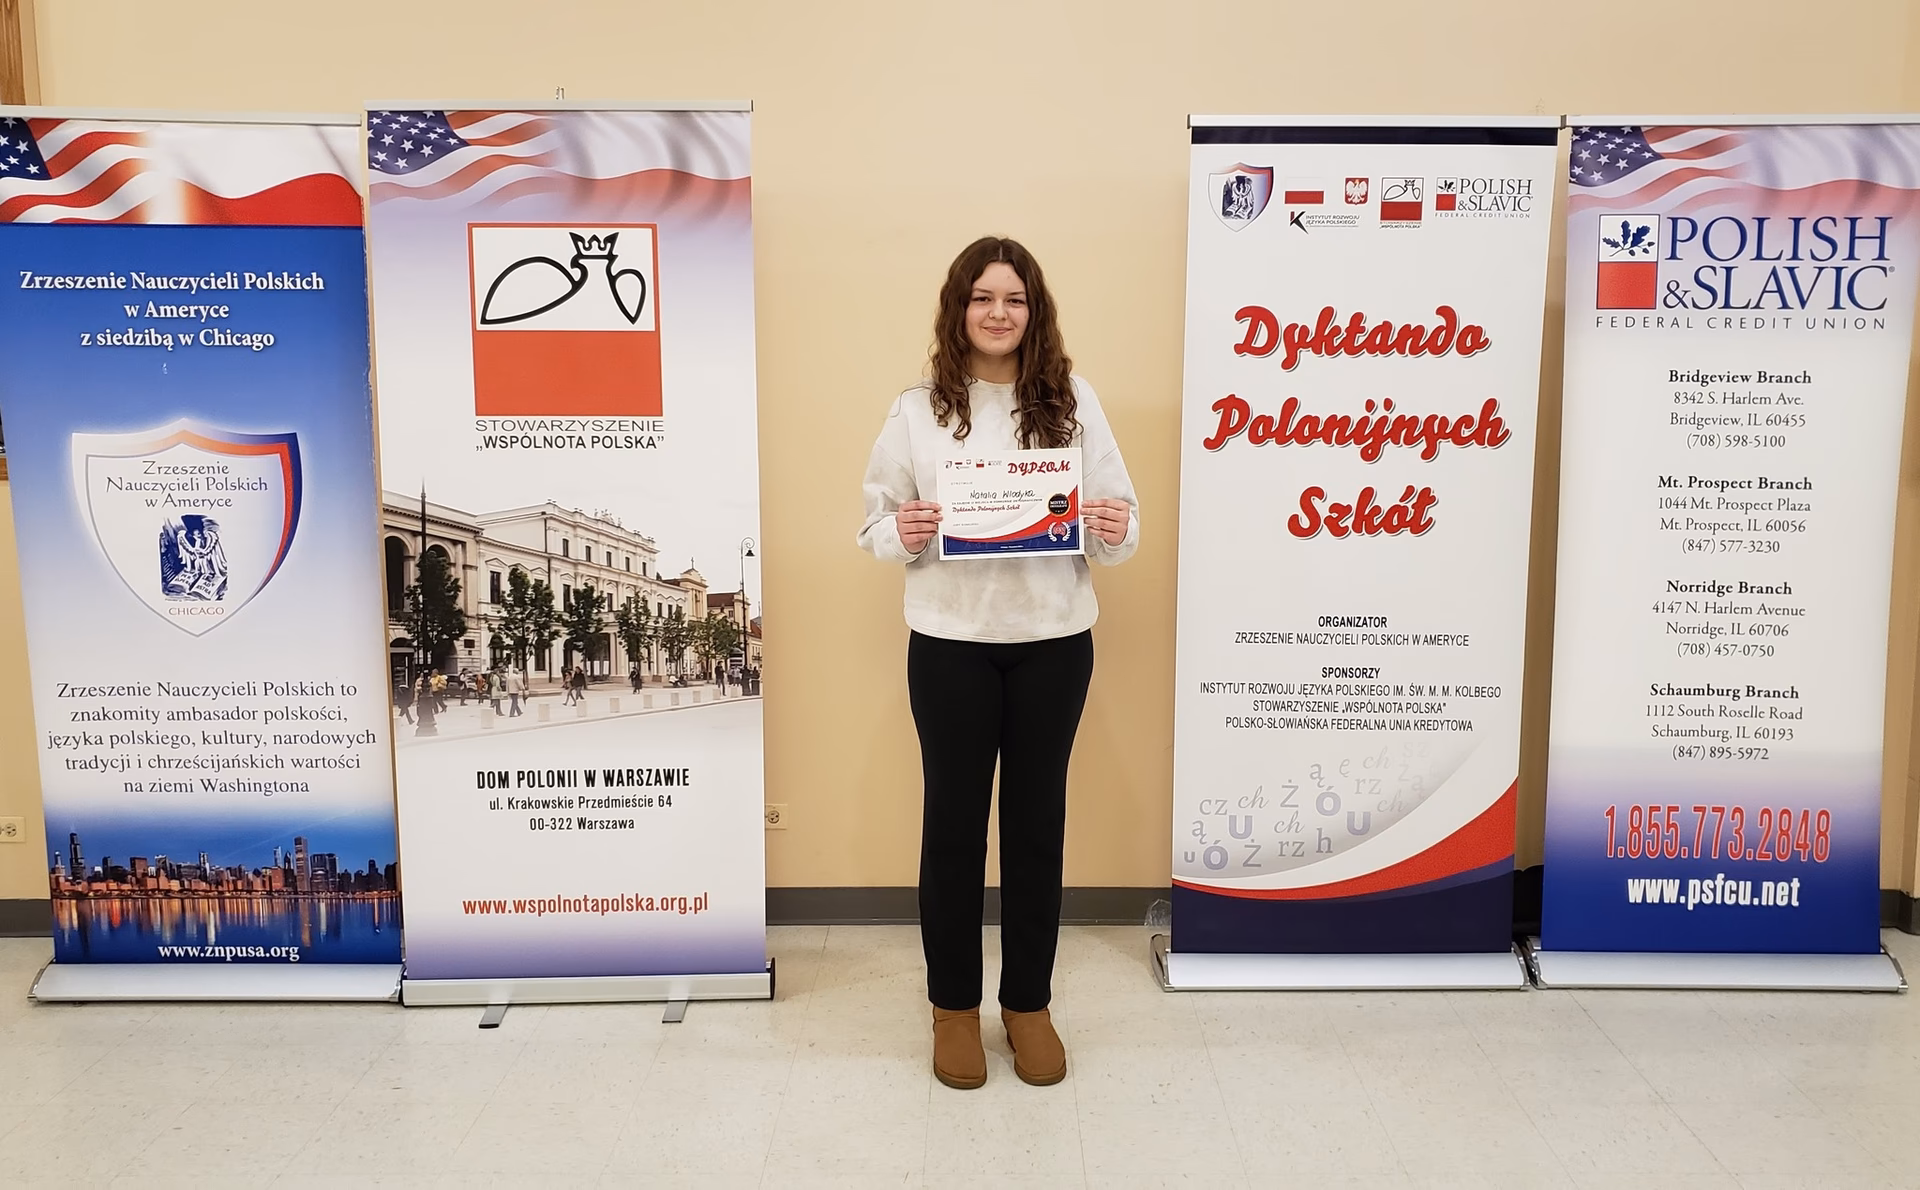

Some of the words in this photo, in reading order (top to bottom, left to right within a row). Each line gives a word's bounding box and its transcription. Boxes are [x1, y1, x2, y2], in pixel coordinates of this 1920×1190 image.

[1459, 178, 1532, 195] POLISH
[1664, 216, 1893, 262] POLISH
[20, 271, 127, 290] Zrzeszenie
[130, 271, 239, 292] Nauczycieli
[243, 272, 325, 290] Polskich
[125, 304, 140, 318] w
[144, 301, 229, 321] Ameryce
[1596, 316, 1693, 329] FEDERAL
[1707, 317, 1792, 329] CREDIT
[1806, 318, 1886, 330] UNION
[81, 332, 92, 347] z
[96, 330, 173, 351] siedzibą
[177, 332, 194, 347] w
[199, 329, 274, 351] Chicago
[1233, 305, 1490, 371] Dyktando
[1668, 370, 1752, 387] Bridgeview
[1756, 370, 1812, 384] Branch
[1673, 391, 1704, 405] 8342
[1707, 392, 1718, 405] S.
[1723, 392, 1772, 406] Harlem
[1775, 393, 1804, 406] Ave.
[475, 420, 664, 432] STOWARZYSZENIE
[1203, 394, 1511, 463] Polonijnych
[1669, 412, 1744, 428] Bridgeview,
[1747, 413, 1762, 426] IL
[1765, 413, 1806, 427] 60455
[475, 432, 586, 451] „WSPÓLNOTA
[1686, 433, 1722, 449] (708)
[1724, 434, 1786, 448] 598-5100
[142, 461, 230, 475] Zrzeszenie
[105, 476, 201, 494] Nauczycieli
[205, 476, 268, 492] Polskich
[1657, 475, 1683, 489] Mt.
[1687, 476, 1753, 492] Prospect
[1757, 477, 1813, 490] Branch
[145, 496, 157, 508] w
[160, 494, 233, 510] Ameryce
[970, 489, 997, 499] Natalia
[1658, 496, 1687, 509] 1044
[1690, 497, 1713, 510] Mt.
[1717, 498, 1773, 514] Prospect
[1776, 498, 1811, 512] Plaza
[1660, 518, 1682, 531] Mt.
[1686, 518, 1744, 535] Prospect,
[1747, 519, 1762, 532] IL
[1765, 519, 1806, 533] 60056
[1682, 538, 1716, 554] (847)
[1719, 539, 1780, 553] 577-3230
[1666, 580, 1733, 598] Norridge
[1738, 581, 1792, 595] Branch
[168, 607, 225, 616] CHICAGO
[1652, 600, 1682, 614] 4147
[1685, 601, 1700, 614] N.
[1704, 601, 1752, 615] Harlem
[1756, 603, 1806, 616] Avenue
[1318, 616, 1387, 628] ORGANIZATOR
[1666, 621, 1727, 639] Norridge,
[1731, 623, 1746, 636] IL
[1748, 623, 1789, 637] 60706
[1235, 632, 1293, 644] ZRZESZENIE
[1296, 632, 1359, 645] NAUCZYCIELI
[1362, 633, 1409, 646] POLSKICH
[1411, 634, 1422, 646] W
[1423, 634, 1469, 646] AMERYCE
[1677, 641, 1711, 658] (708)
[1714, 643, 1775, 657] 457-0750
[1322, 667, 1380, 679] SPONSORZY
[57, 682, 152, 698] Zrzeszenie
[157, 681, 257, 700] Nauczycieli
[263, 681, 334, 697] Polskich
[340, 684, 357, 697] to
[1200, 683, 1246, 694] INSTYTUT
[1248, 683, 1296, 695] ROZWOJU
[1298, 684, 1334, 698] JĘZYKA
[1335, 684, 1391, 696] POLSKIEGO
[1393, 685, 1406, 697] IM.
[1409, 683, 1426, 697] ŚW.
[1428, 686, 1439, 697] M.
[1441, 686, 1452, 697] M.
[1455, 686, 1501, 698] KOLBEGO
[1650, 683, 1741, 701] Schaumburg
[1745, 685, 1799, 699] Branch
[1253, 699, 1338, 712] STOWARZYSZENIE
[1646, 704, 1674, 717] 1112
[1677, 704, 1715, 718] South
[1718, 705, 1765, 719] Roselle
[1769, 706, 1803, 720] Road
[70, 707, 161, 724] znakomity
[166, 706, 258, 722] ambasador
[264, 706, 348, 724] polskości,
[1225, 714, 1328, 729] POLSKO-SŁOWIAŃSKA
[1331, 718, 1386, 730] FEDERALNA
[1389, 719, 1412, 731] UNIA
[1413, 719, 1473, 731] KREDYTOWA
[47, 731, 104, 750] języka
[109, 730, 196, 748] polskiego,
[201, 730, 267, 748] kultury,
[272, 730, 376, 747] narodowych
[1651, 724, 1732, 742] Schaumburg,
[1735, 725, 1750, 739] IL
[1754, 726, 1794, 741] 60193
[1672, 744, 1706, 761] (847)
[1709, 745, 1769, 760] 895-5972
[65, 756, 131, 772] tradycji
[137, 755, 142, 769] i
[147, 753, 284, 772] chrześcijańskich
[290, 753, 361, 769] wartości
[1309, 763, 1325, 788] ą
[1338, 758, 1350, 778] ę
[1362, 745, 1391, 769] ch
[124, 782, 144, 792] na
[149, 779, 194, 793] ziemi
[199, 778, 310, 796] Washingtona
[477, 770, 510, 789] DOM
[517, 769, 578, 788] POLONII
[584, 769, 597, 787] W
[602, 768, 690, 787] WARSZAWIE
[1355, 778, 1382, 795] rz
[489, 797, 503, 811] ul.
[507, 796, 574, 810] Krakowskie
[578, 794, 654, 809] Przedmieście
[658, 794, 672, 808] 64
[1200, 799, 1228, 815] cz
[1238, 785, 1269, 809] ch
[1376, 789, 1406, 812] ch
[529, 817, 573, 831] 00-322
[577, 816, 635, 830] Warszawa
[1192, 820, 1207, 845] ą
[1274, 810, 1305, 834] ch
[1604, 804, 1831, 862] 1.855.773.2848
[1278, 840, 1305, 857] rz
[1316, 828, 1333, 853] h
[1627, 873, 1800, 910] www.psfcu.net
[462, 892, 708, 917] www.wspolnotapolska.org.pl
[158, 944, 300, 962] www.znpusa.org
